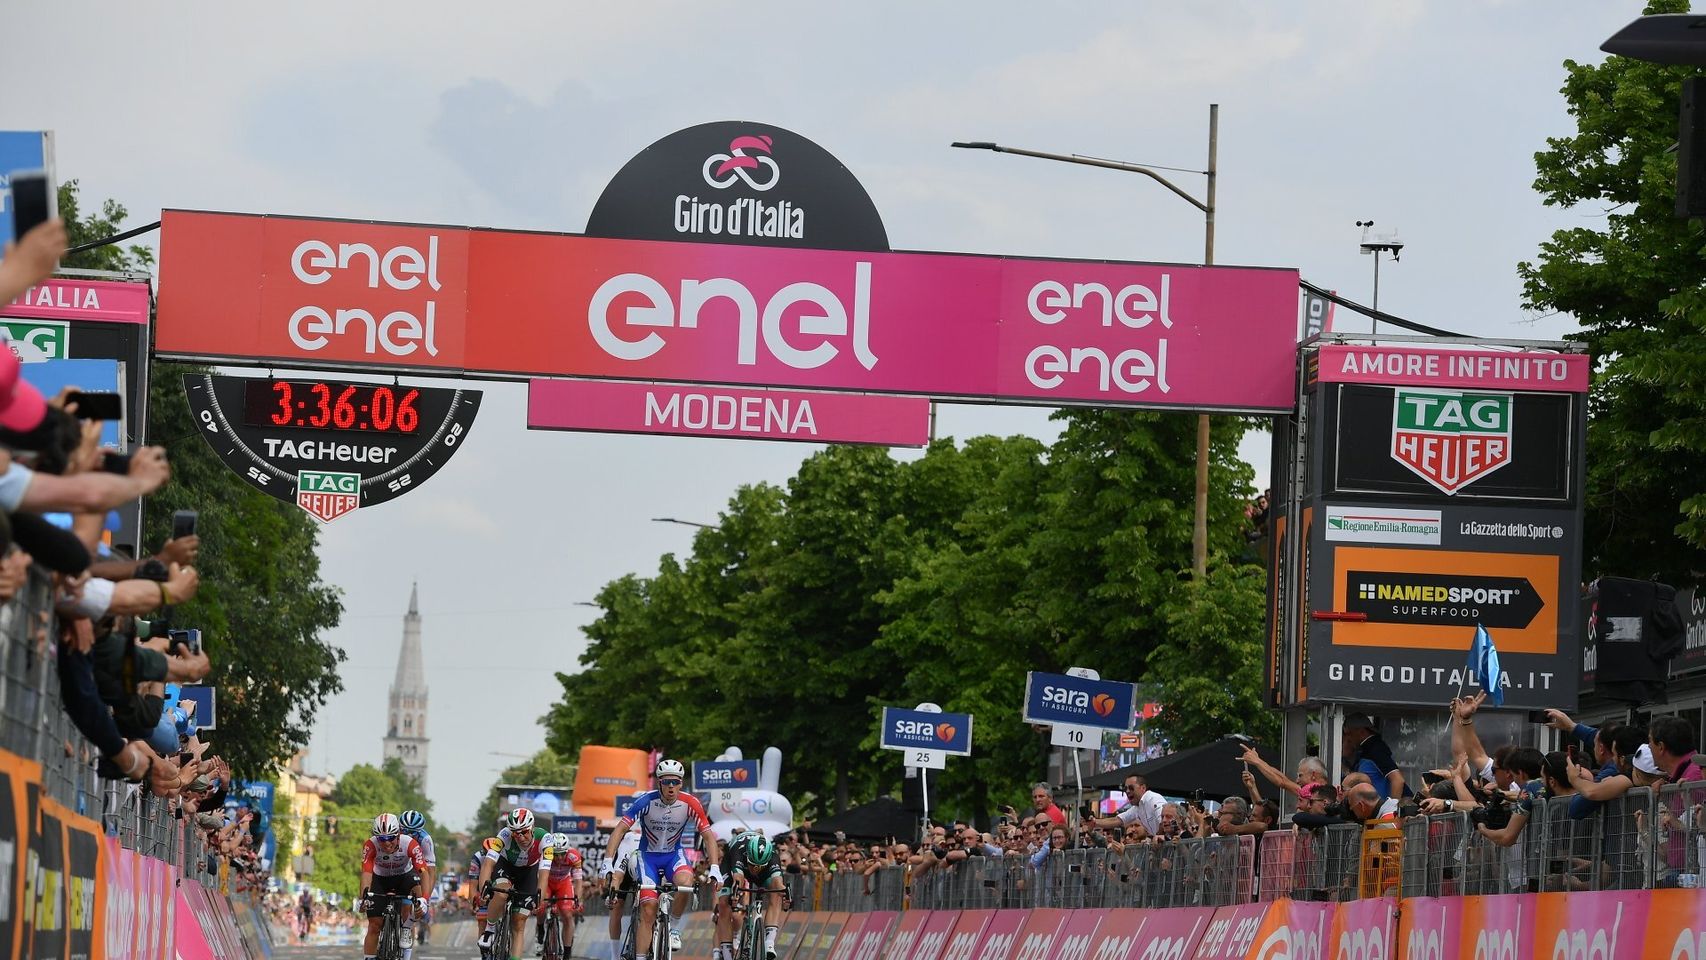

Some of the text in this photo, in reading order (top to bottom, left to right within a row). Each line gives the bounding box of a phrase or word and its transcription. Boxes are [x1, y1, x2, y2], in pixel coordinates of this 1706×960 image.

[673, 194, 805, 239] Giro d'Italia
[291, 235, 442, 291] enel
[1027, 273, 1174, 329] enel
[588, 261, 879, 371] enel
[288, 301, 439, 357] enel
[1025, 338, 1171, 394] enel
[1341, 352, 1569, 381] AMORE INFINITO
[271, 381, 420, 432] 3:36:06
[644, 391, 818, 435] MODENA
[1404, 396, 1501, 429] TAG
[200, 409, 219, 433] 40
[444, 422, 463, 447] 20
[1399, 435, 1504, 486] HEUER
[247, 466, 272, 486] 35
[303, 474, 355, 492] TAG
[388, 473, 412, 493] 25
[300, 493, 356, 520] HEUER
[1507, 523, 1528, 538] dello
[1528, 523, 1551, 540] Sport
[1392, 605, 1480, 618] SUPERFOOD
[1328, 663, 1554, 690] GIRODITALA.IT
[1042, 685, 1090, 708] sara
[1051, 703, 1088, 715] ASSICURA
[895, 719, 934, 736] sara
[1068, 730, 1083, 743] 10
[916, 752, 930, 763] 25
[702, 768, 732, 780] sara
[721, 792, 731, 800] 50
[557, 820, 577, 829] sara
